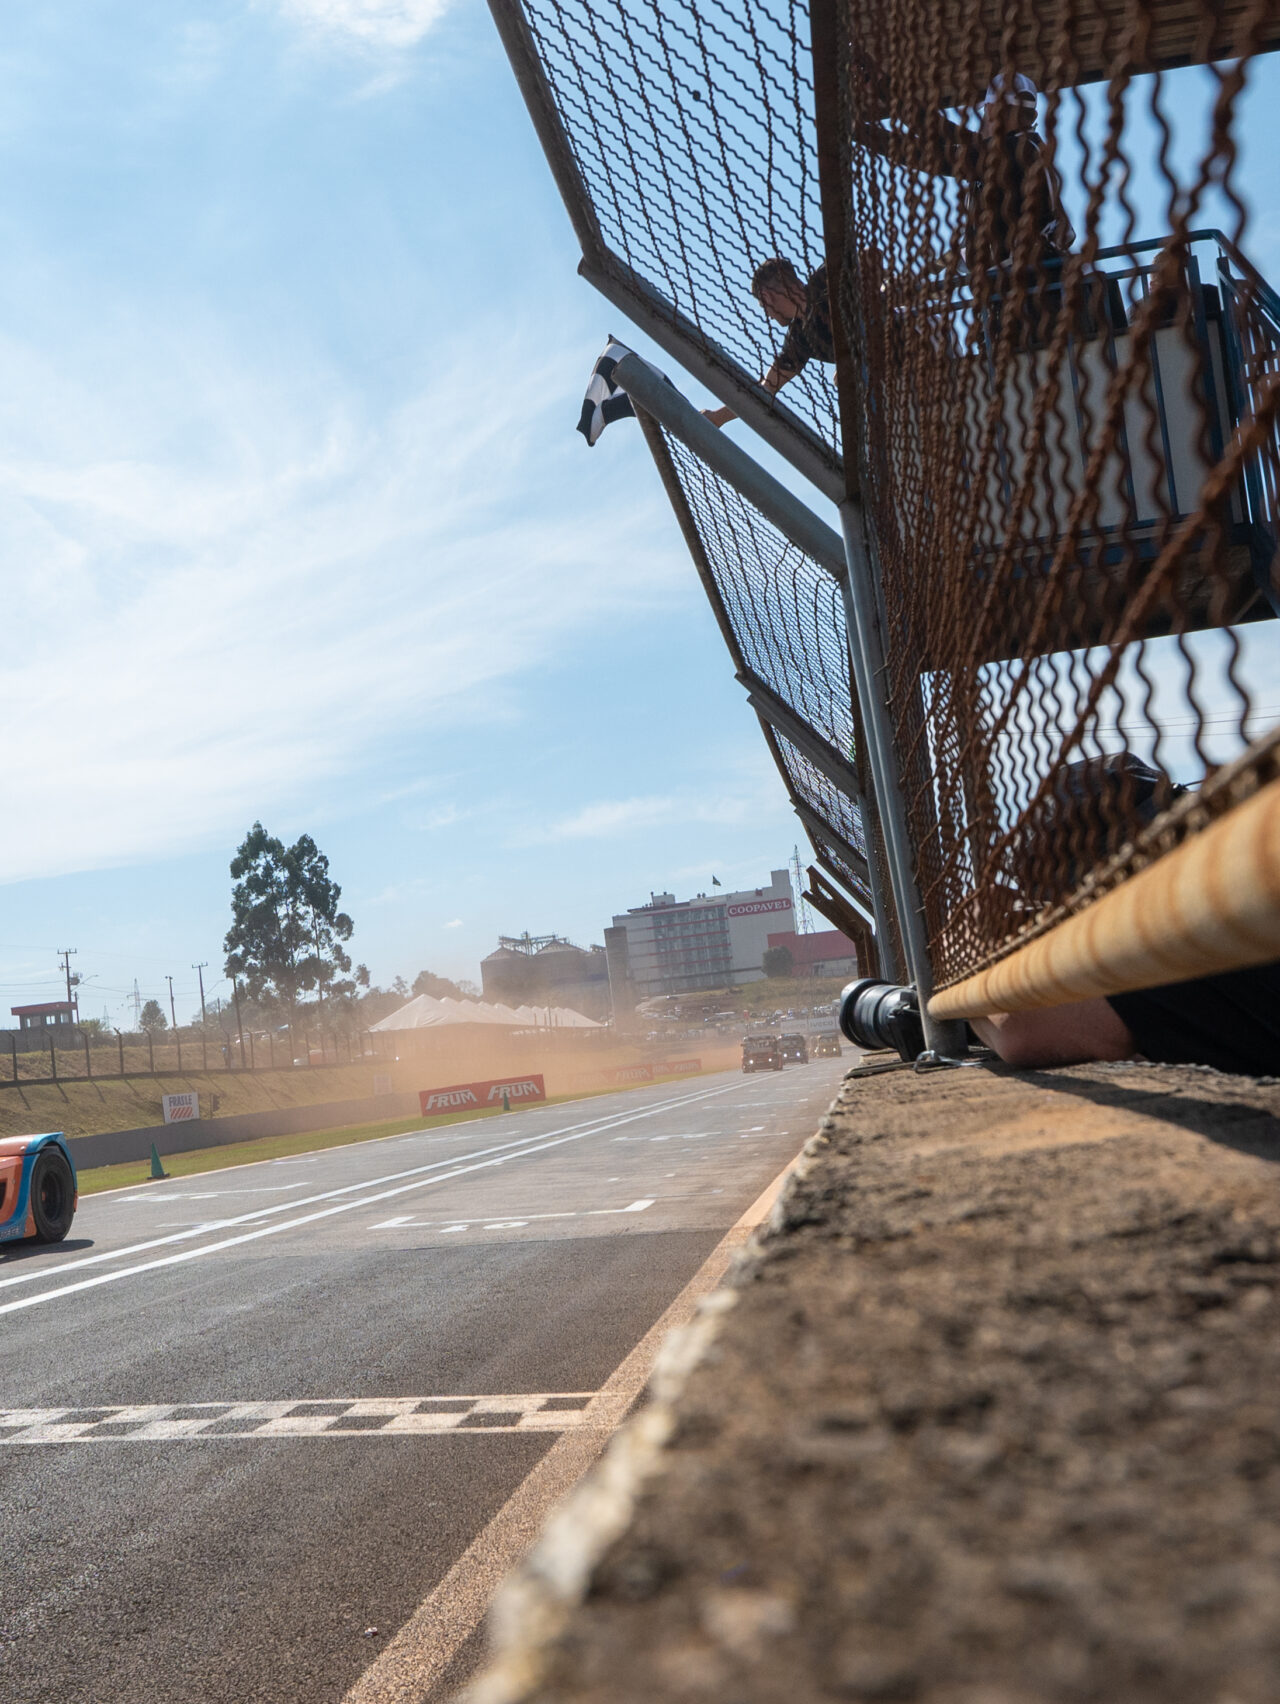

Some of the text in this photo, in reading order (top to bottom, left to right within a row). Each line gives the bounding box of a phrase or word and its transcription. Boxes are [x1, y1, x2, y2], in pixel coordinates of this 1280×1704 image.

[729, 900, 790, 915] COOPAVEL
[425, 1081, 541, 1111] FRUM FRUM
